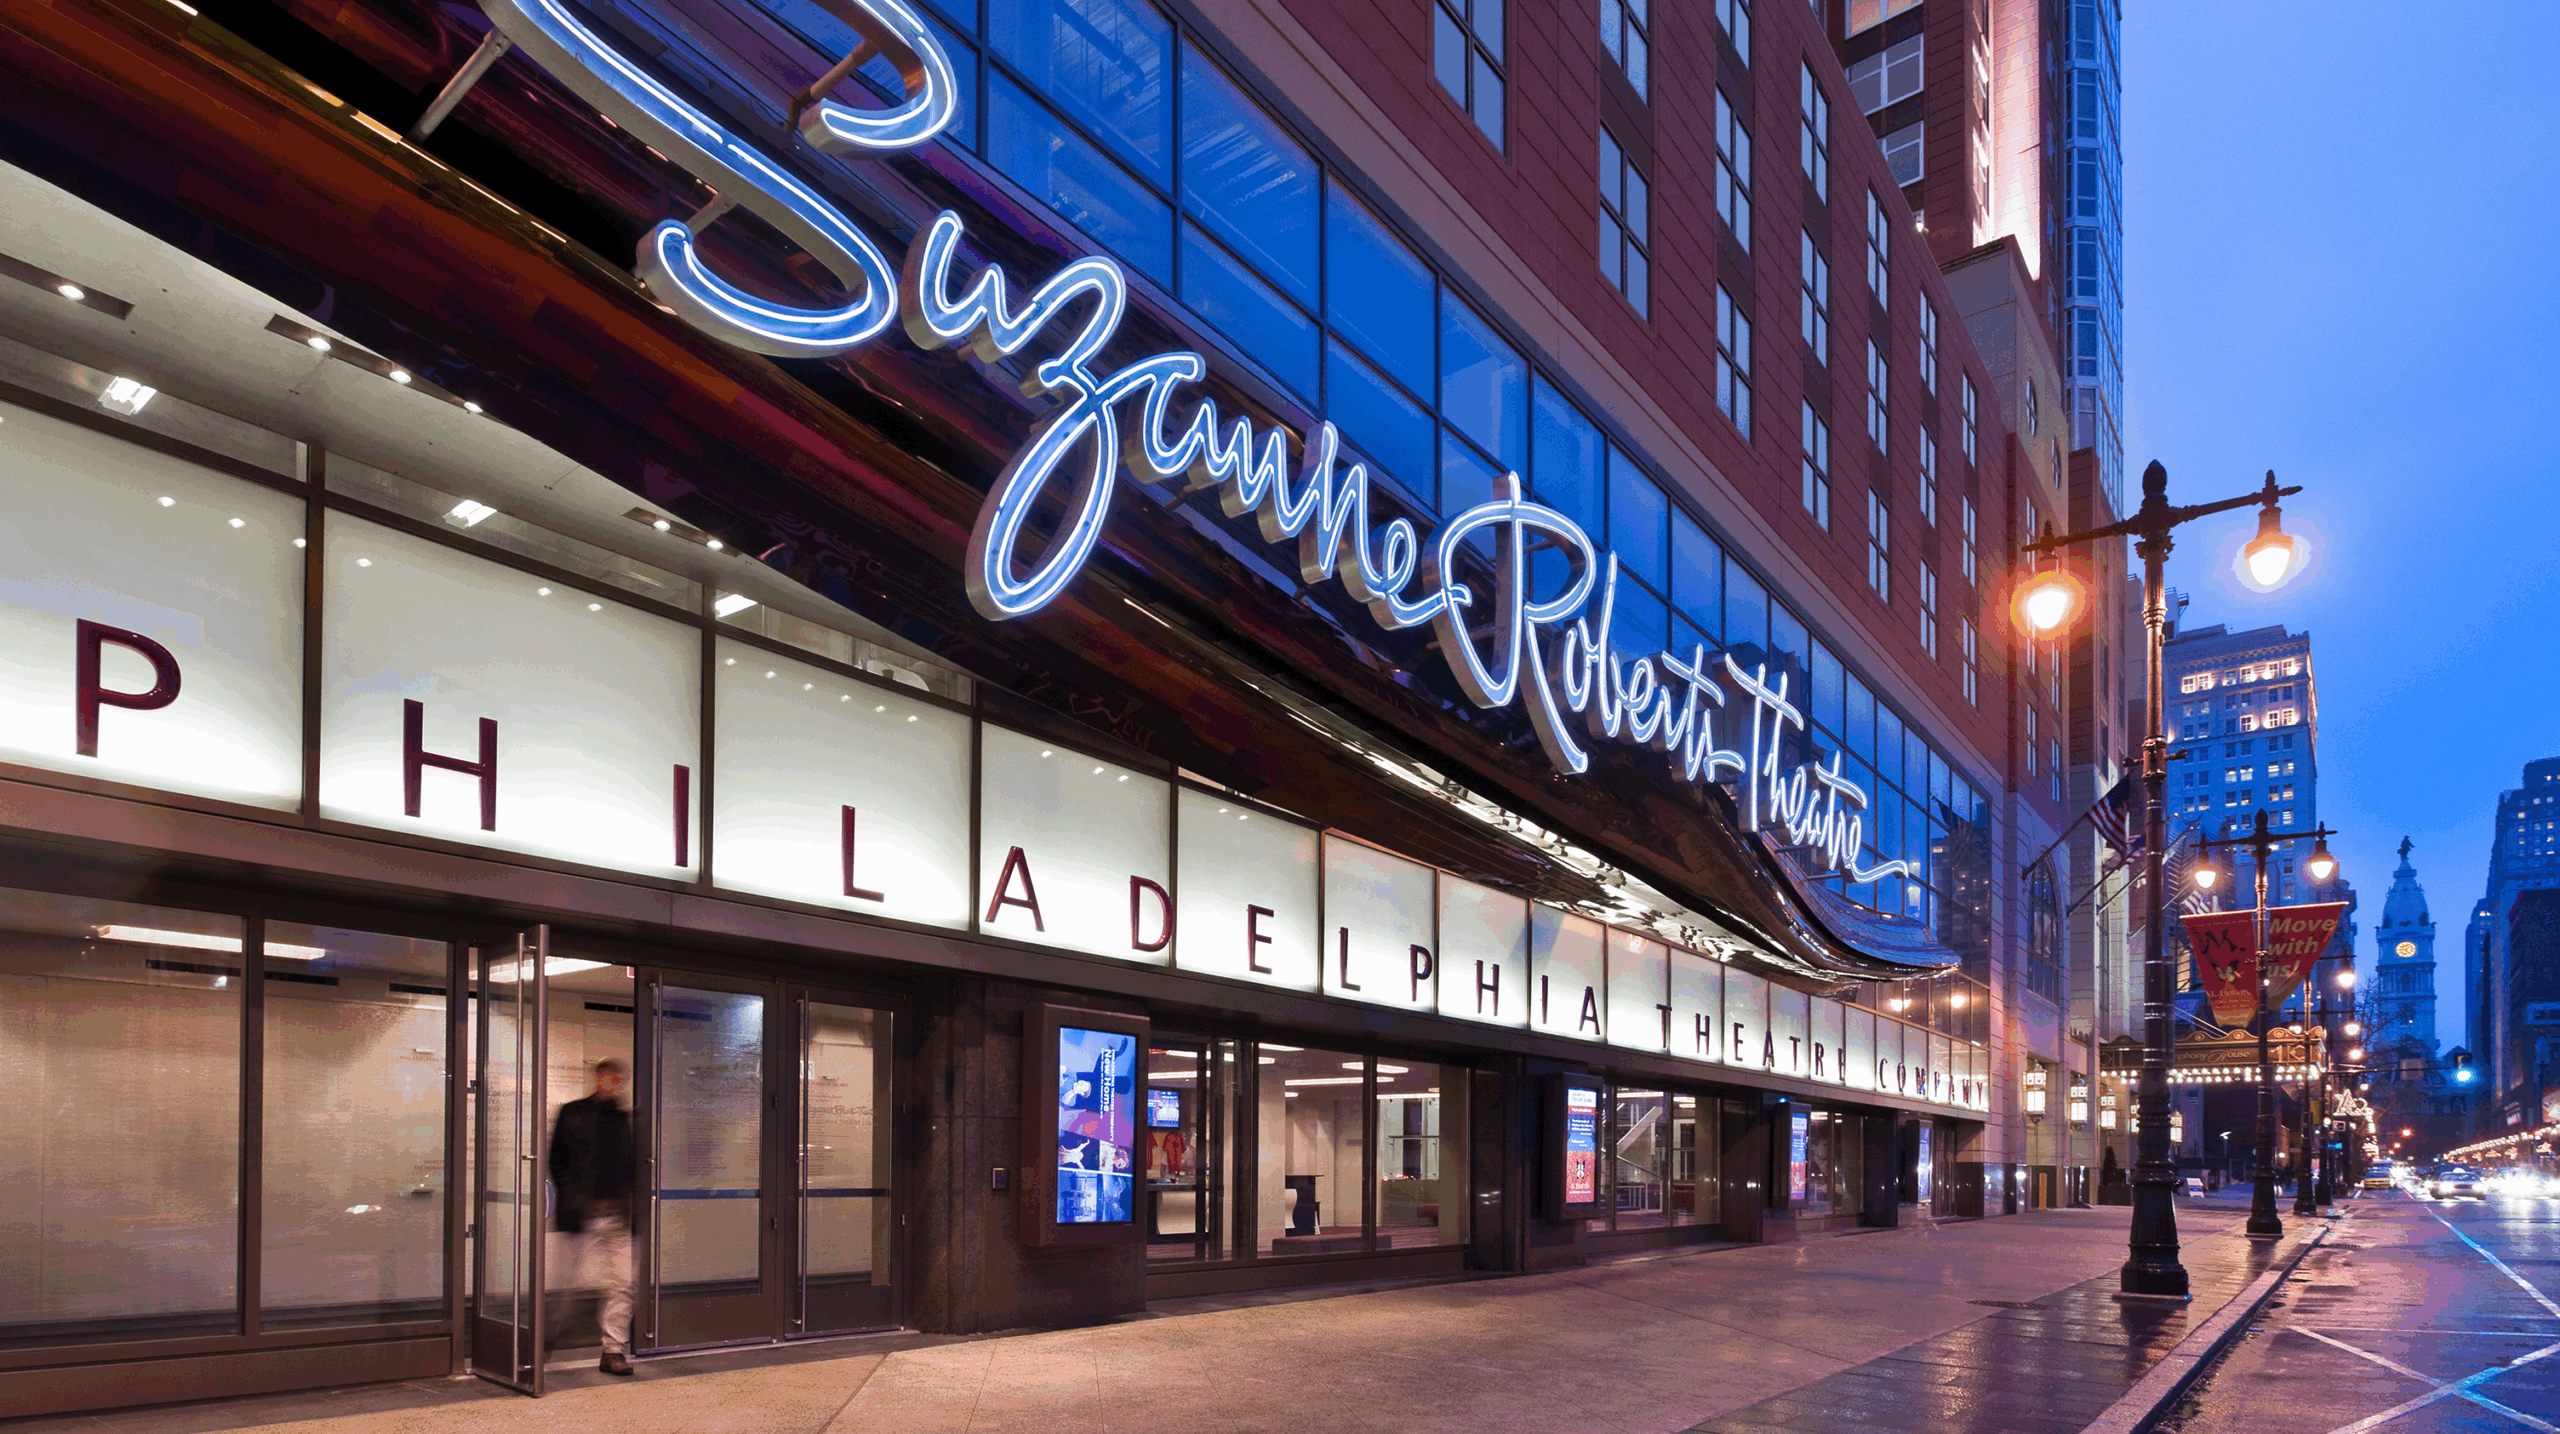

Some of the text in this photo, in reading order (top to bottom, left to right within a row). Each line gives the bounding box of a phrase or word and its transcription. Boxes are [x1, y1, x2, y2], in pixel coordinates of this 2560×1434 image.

[478, 0, 1909, 884] Suzanne Roberts Theatre
[75, 617, 1984, 1106] PHILADELPHIA THEATRE COMPANY
[2268, 917, 2337, 934] Move
[2267, 936, 2318, 956] with
[1103, 1077, 1111, 1112] Home
